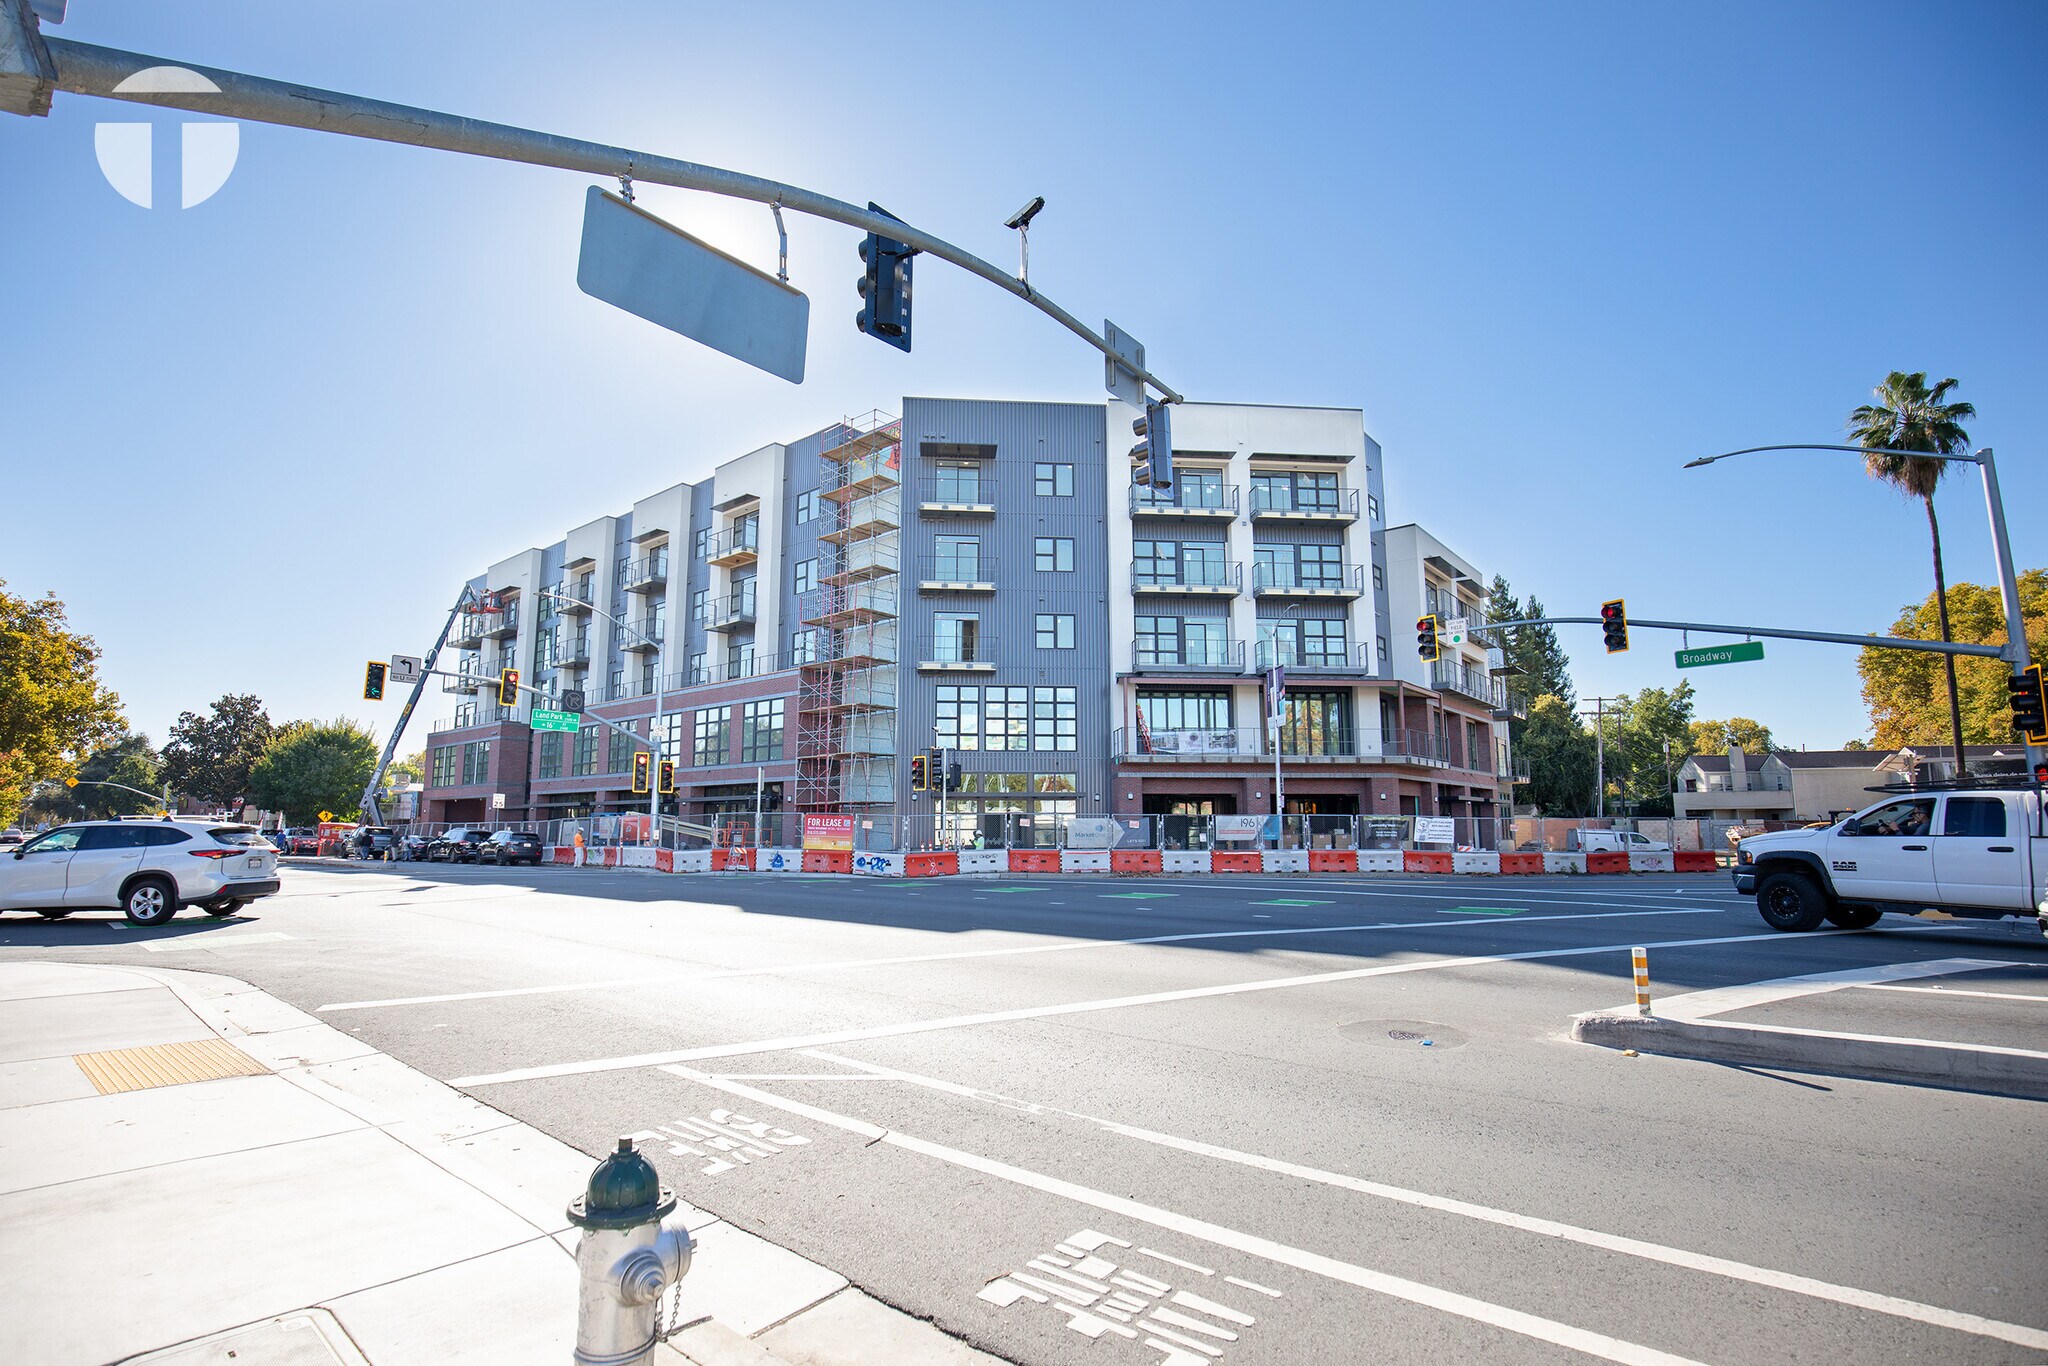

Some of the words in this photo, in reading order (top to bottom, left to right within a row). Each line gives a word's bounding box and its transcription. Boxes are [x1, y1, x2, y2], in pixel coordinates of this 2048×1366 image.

[1682, 651, 1733, 664] Broadway
[535, 711, 550, 719] Land
[550, 712, 563, 720] Park
[807, 818, 821, 826] FOR
[822, 818, 842, 827] LEASE
[618, 1108, 814, 1177] BIKE
[975, 1228, 1283, 1366] LANE
